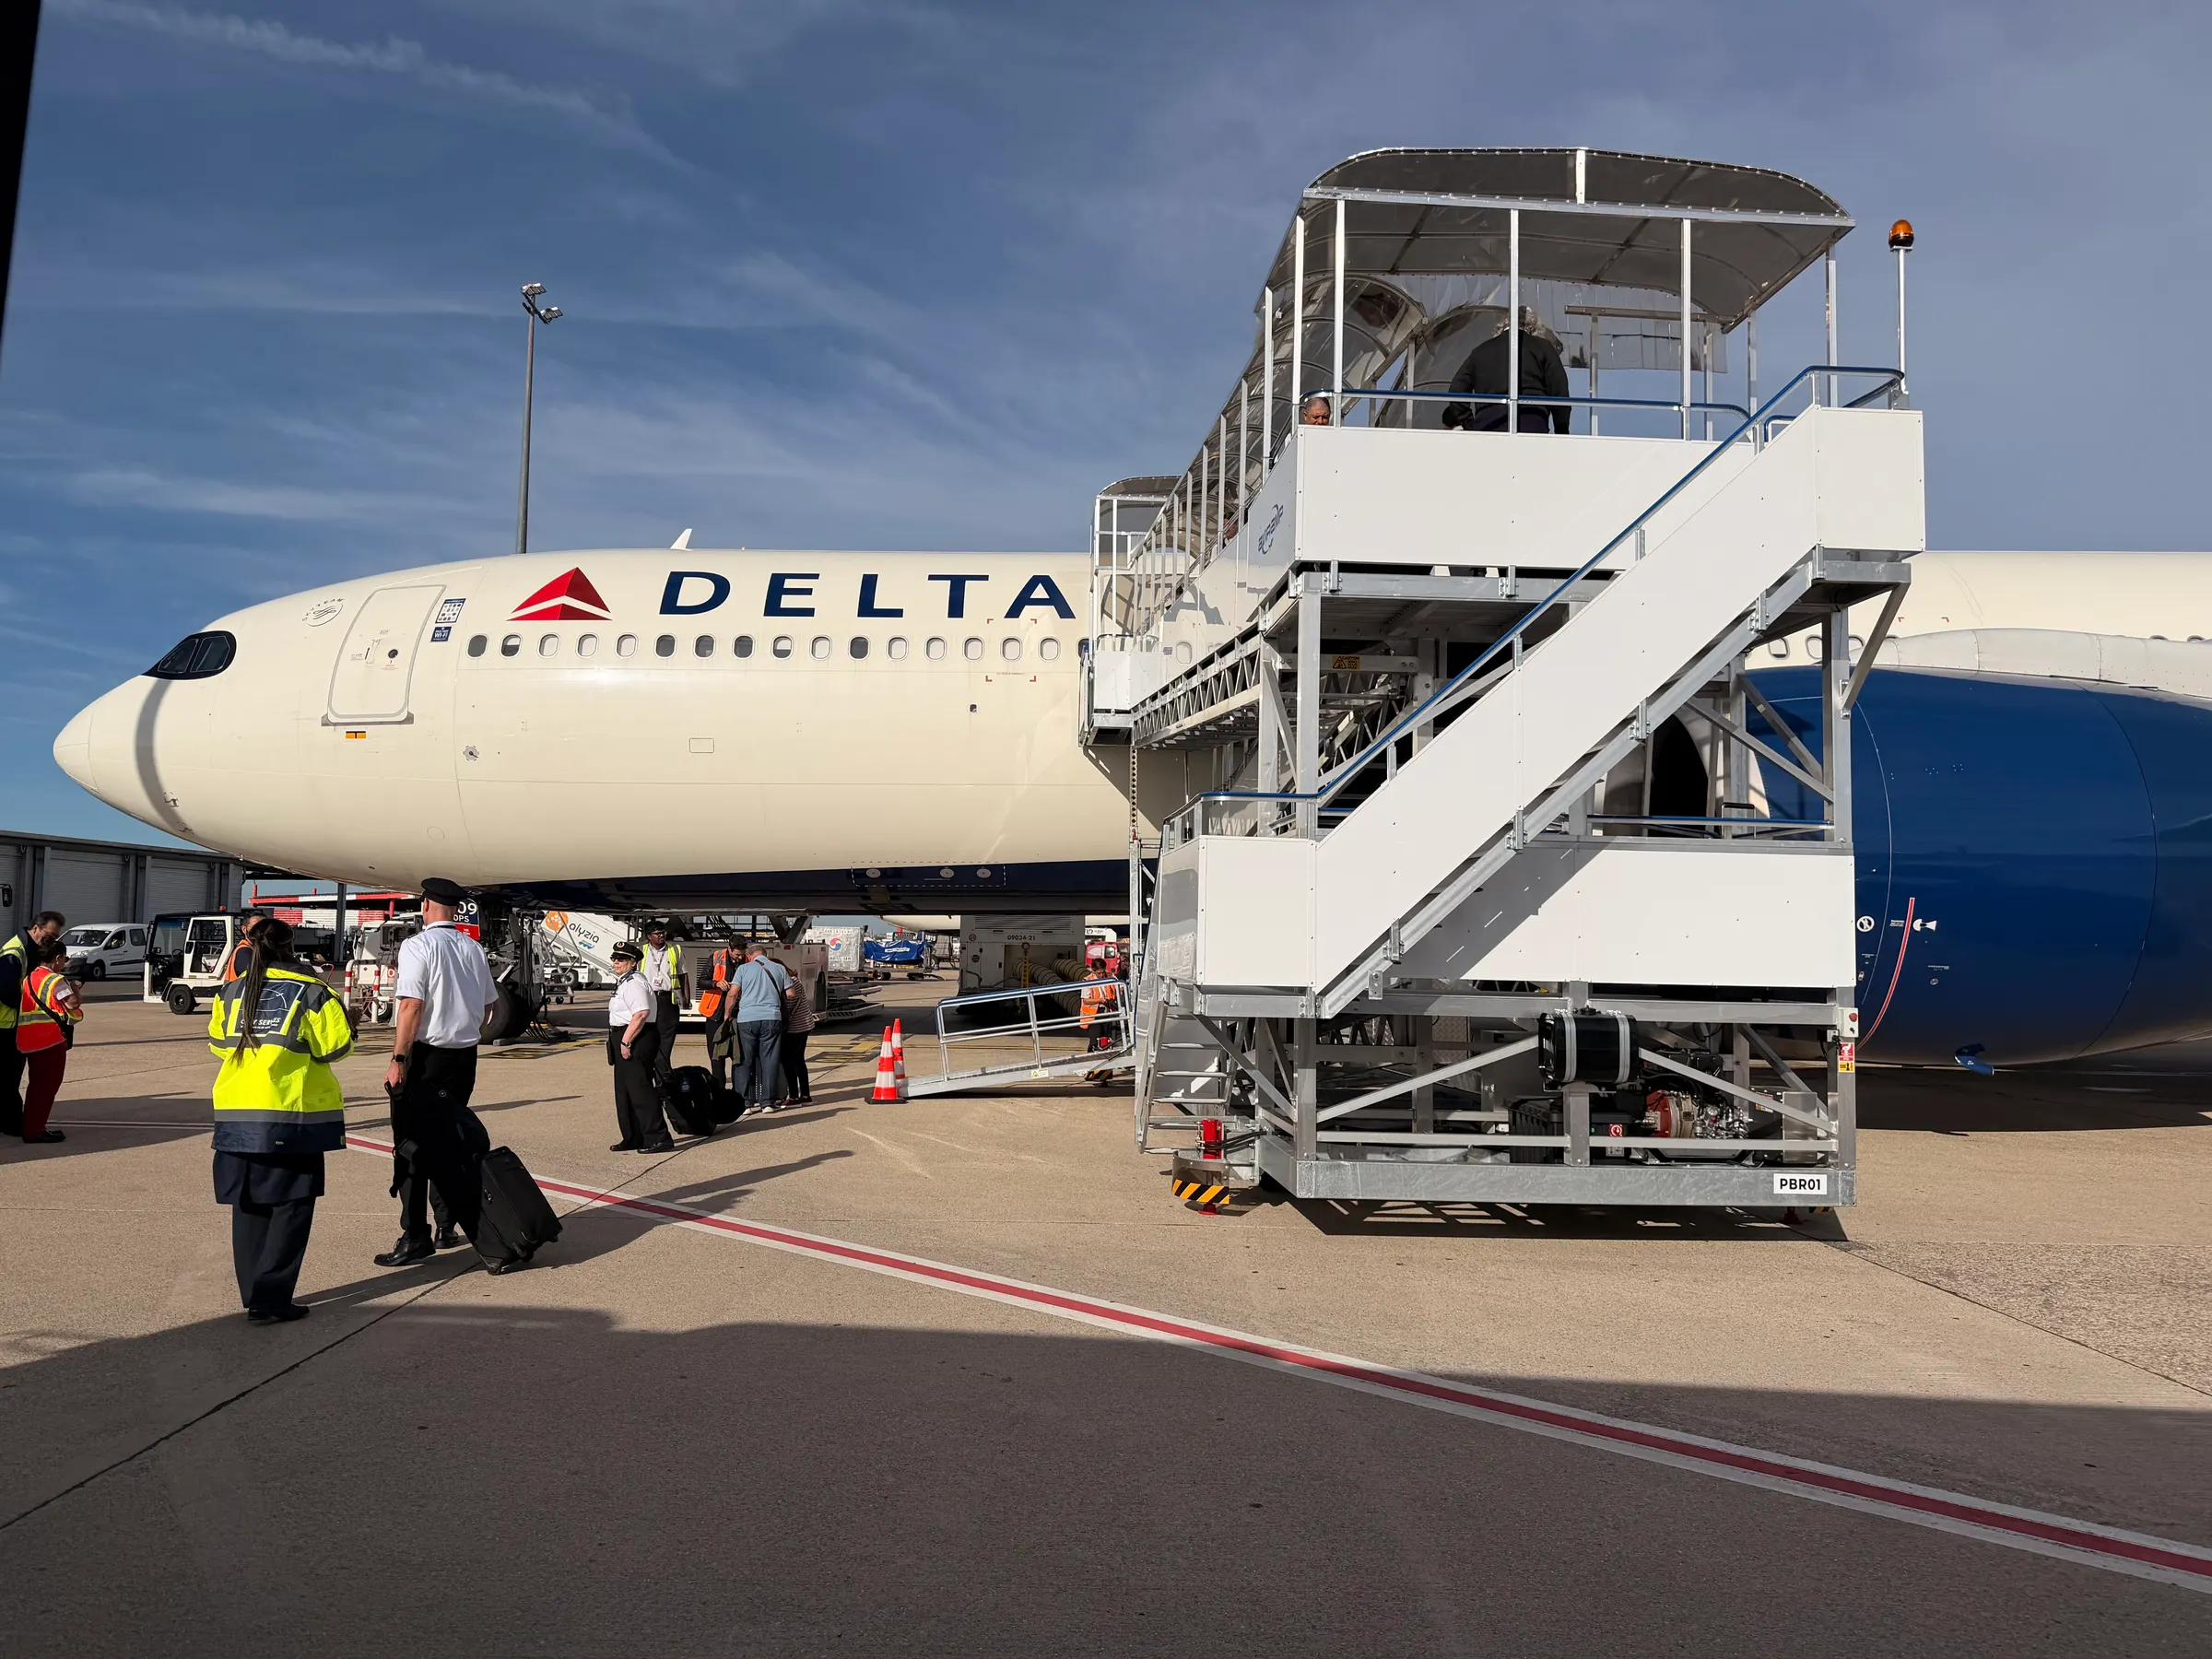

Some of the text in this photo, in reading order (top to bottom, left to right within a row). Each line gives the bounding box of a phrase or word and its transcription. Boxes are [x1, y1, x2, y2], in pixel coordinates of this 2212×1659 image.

[659, 571, 1077, 619] DELTA
[569, 923, 600, 944] alyzia
[1780, 1178, 1820, 1191] PBR01
